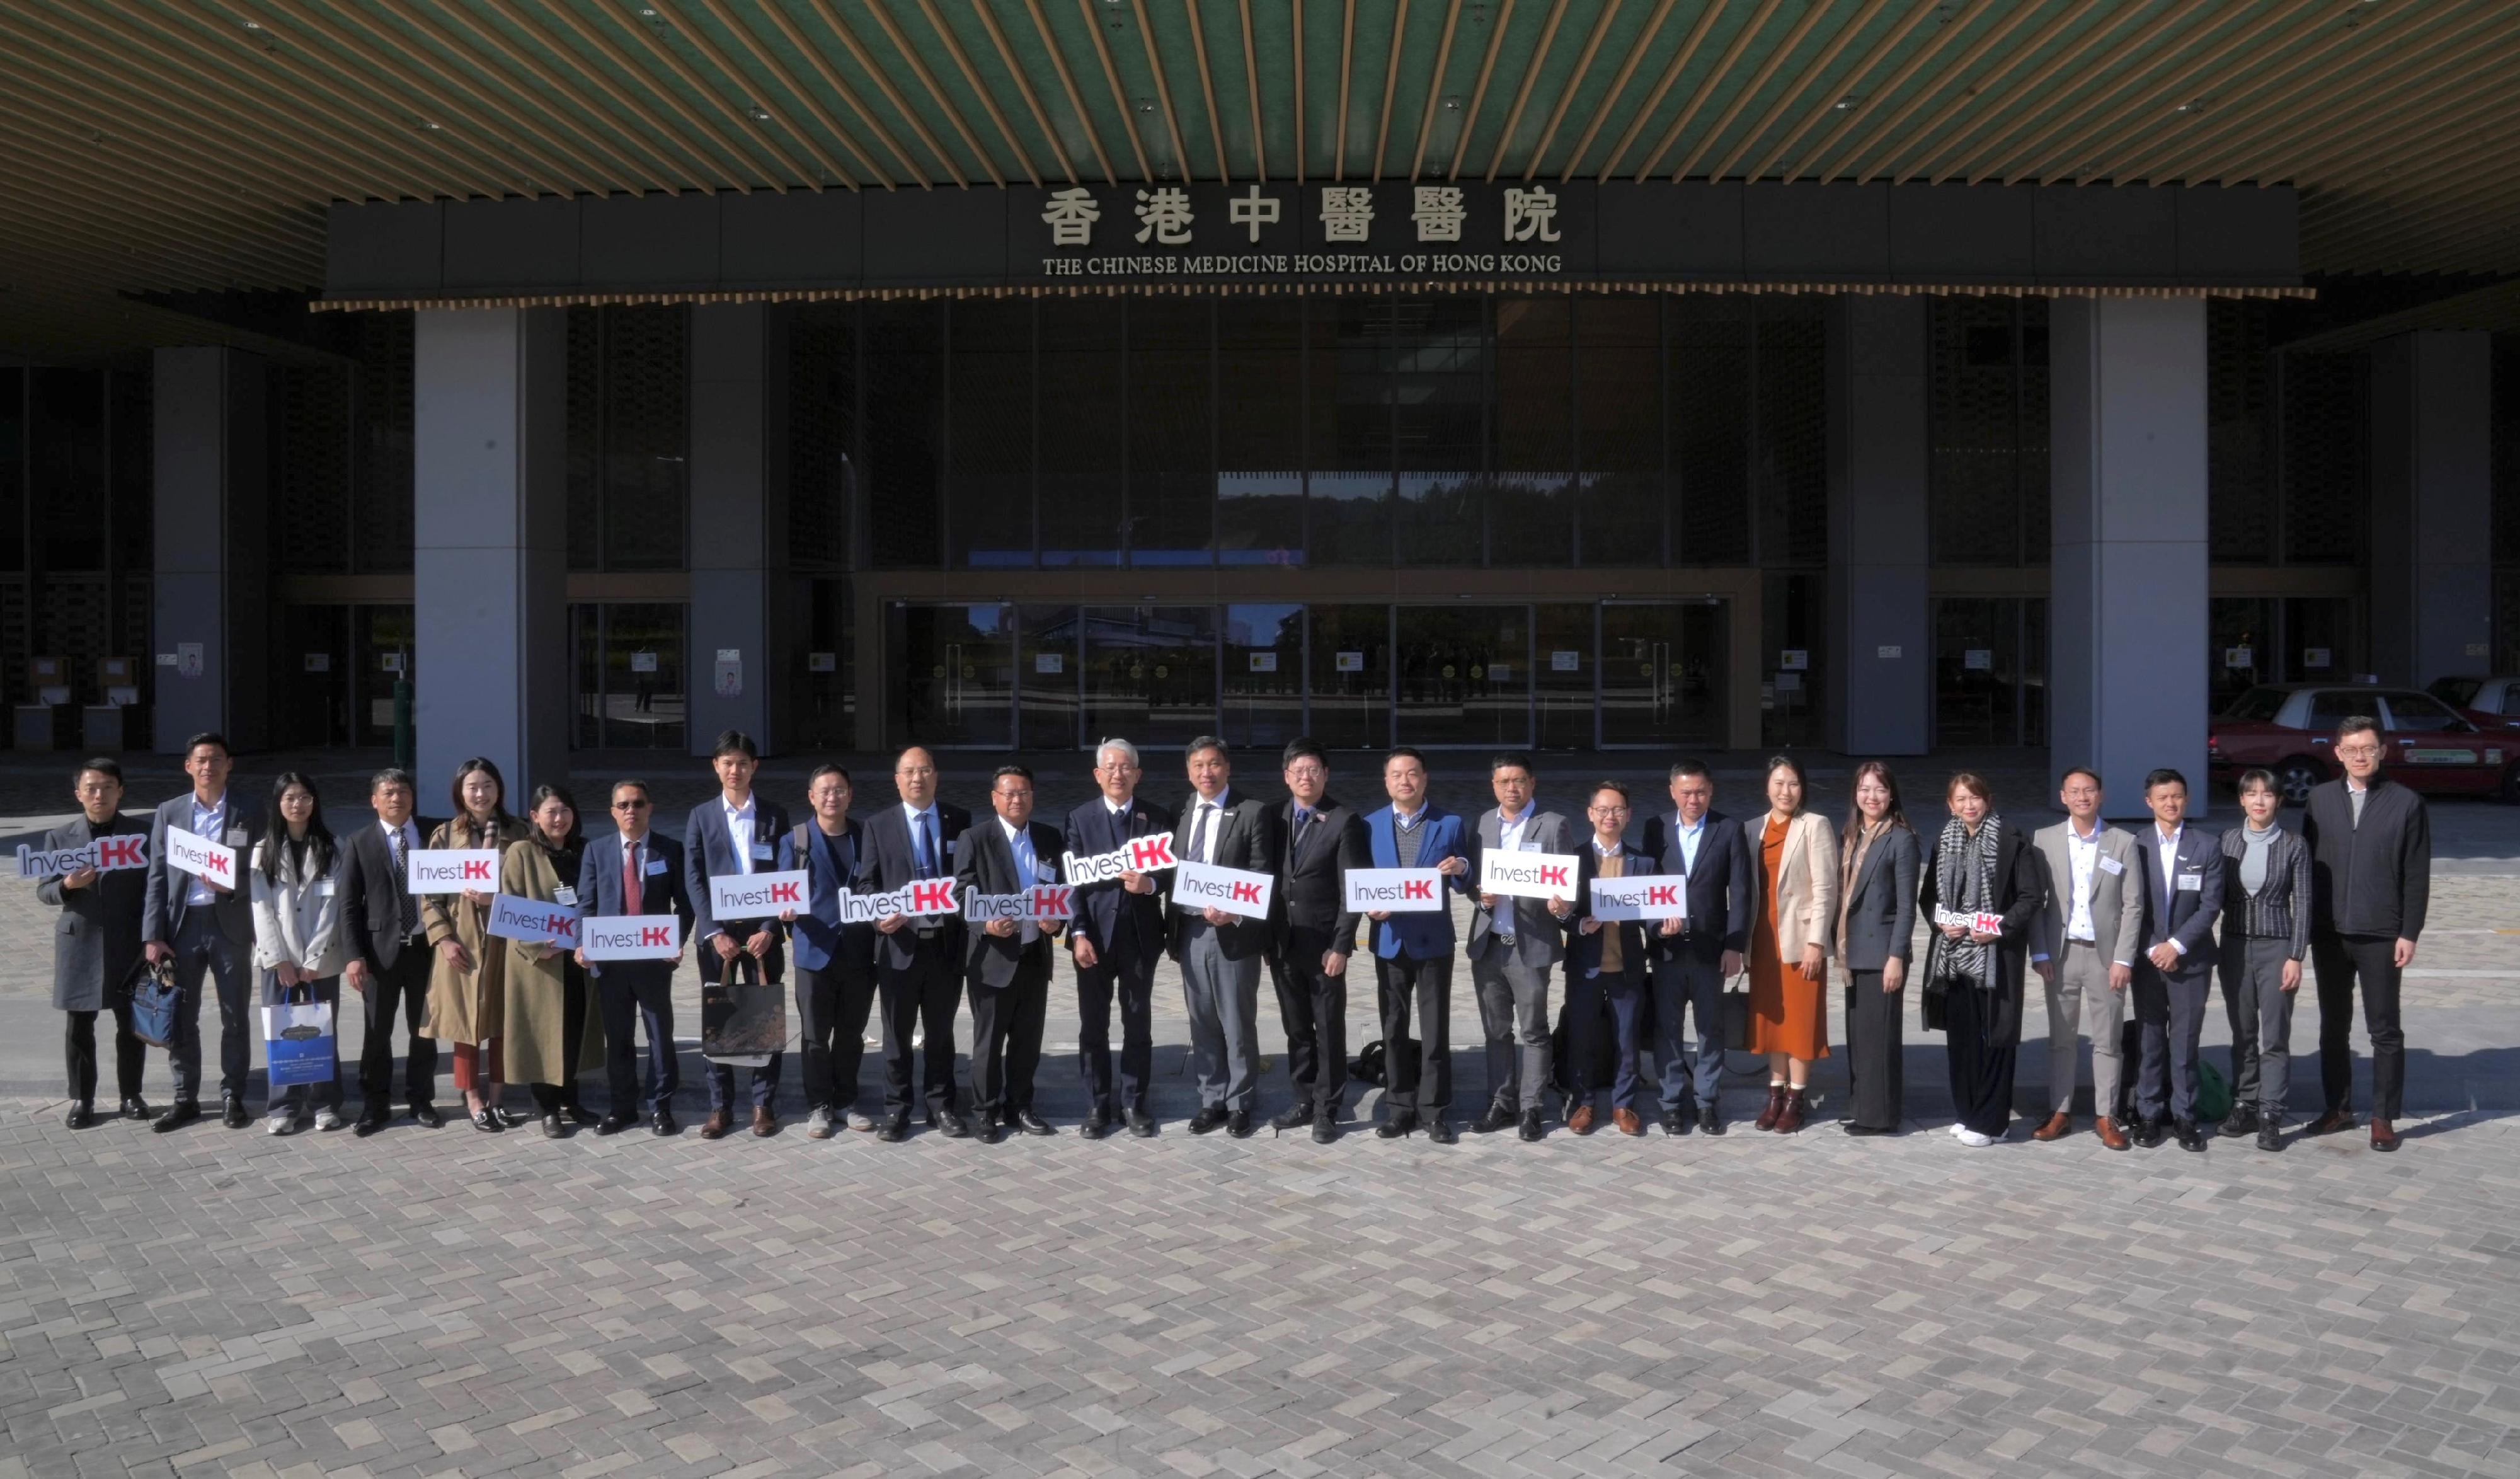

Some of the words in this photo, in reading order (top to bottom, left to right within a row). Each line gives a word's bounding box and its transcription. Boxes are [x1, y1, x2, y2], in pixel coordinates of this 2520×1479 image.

[1041, 184, 1562, 246] 香港中醫醫院
[1043, 258, 1082, 275] THE
[1087, 256, 1177, 275] CHINESE
[1183, 255, 1288, 275] MEDICINE
[1294, 255, 1395, 273] HOSPITAL
[1400, 254, 1427, 273] OF
[1432, 254, 1495, 273] HONG
[1500, 255, 1562, 273] KONG
[23, 838, 143, 875] InvestHK
[173, 837, 229, 875] InvestHK
[416, 860, 492, 880] InvestHK
[1067, 836, 1173, 883] InvestHK
[1184, 872, 1264, 905] InvestHK
[1491, 860, 1568, 887] InvestHK
[720, 881, 801, 908] InvestHK
[843, 881, 954, 920] InvestHK
[969, 888, 1072, 918] InvestHK
[1354, 880, 1433, 901] InvestHK
[1599, 884, 1678, 908] InvestHK
[498, 903, 575, 937] InvestHK
[1935, 904, 2003, 935] InvestHK
[591, 926, 671, 949] InvestHK
